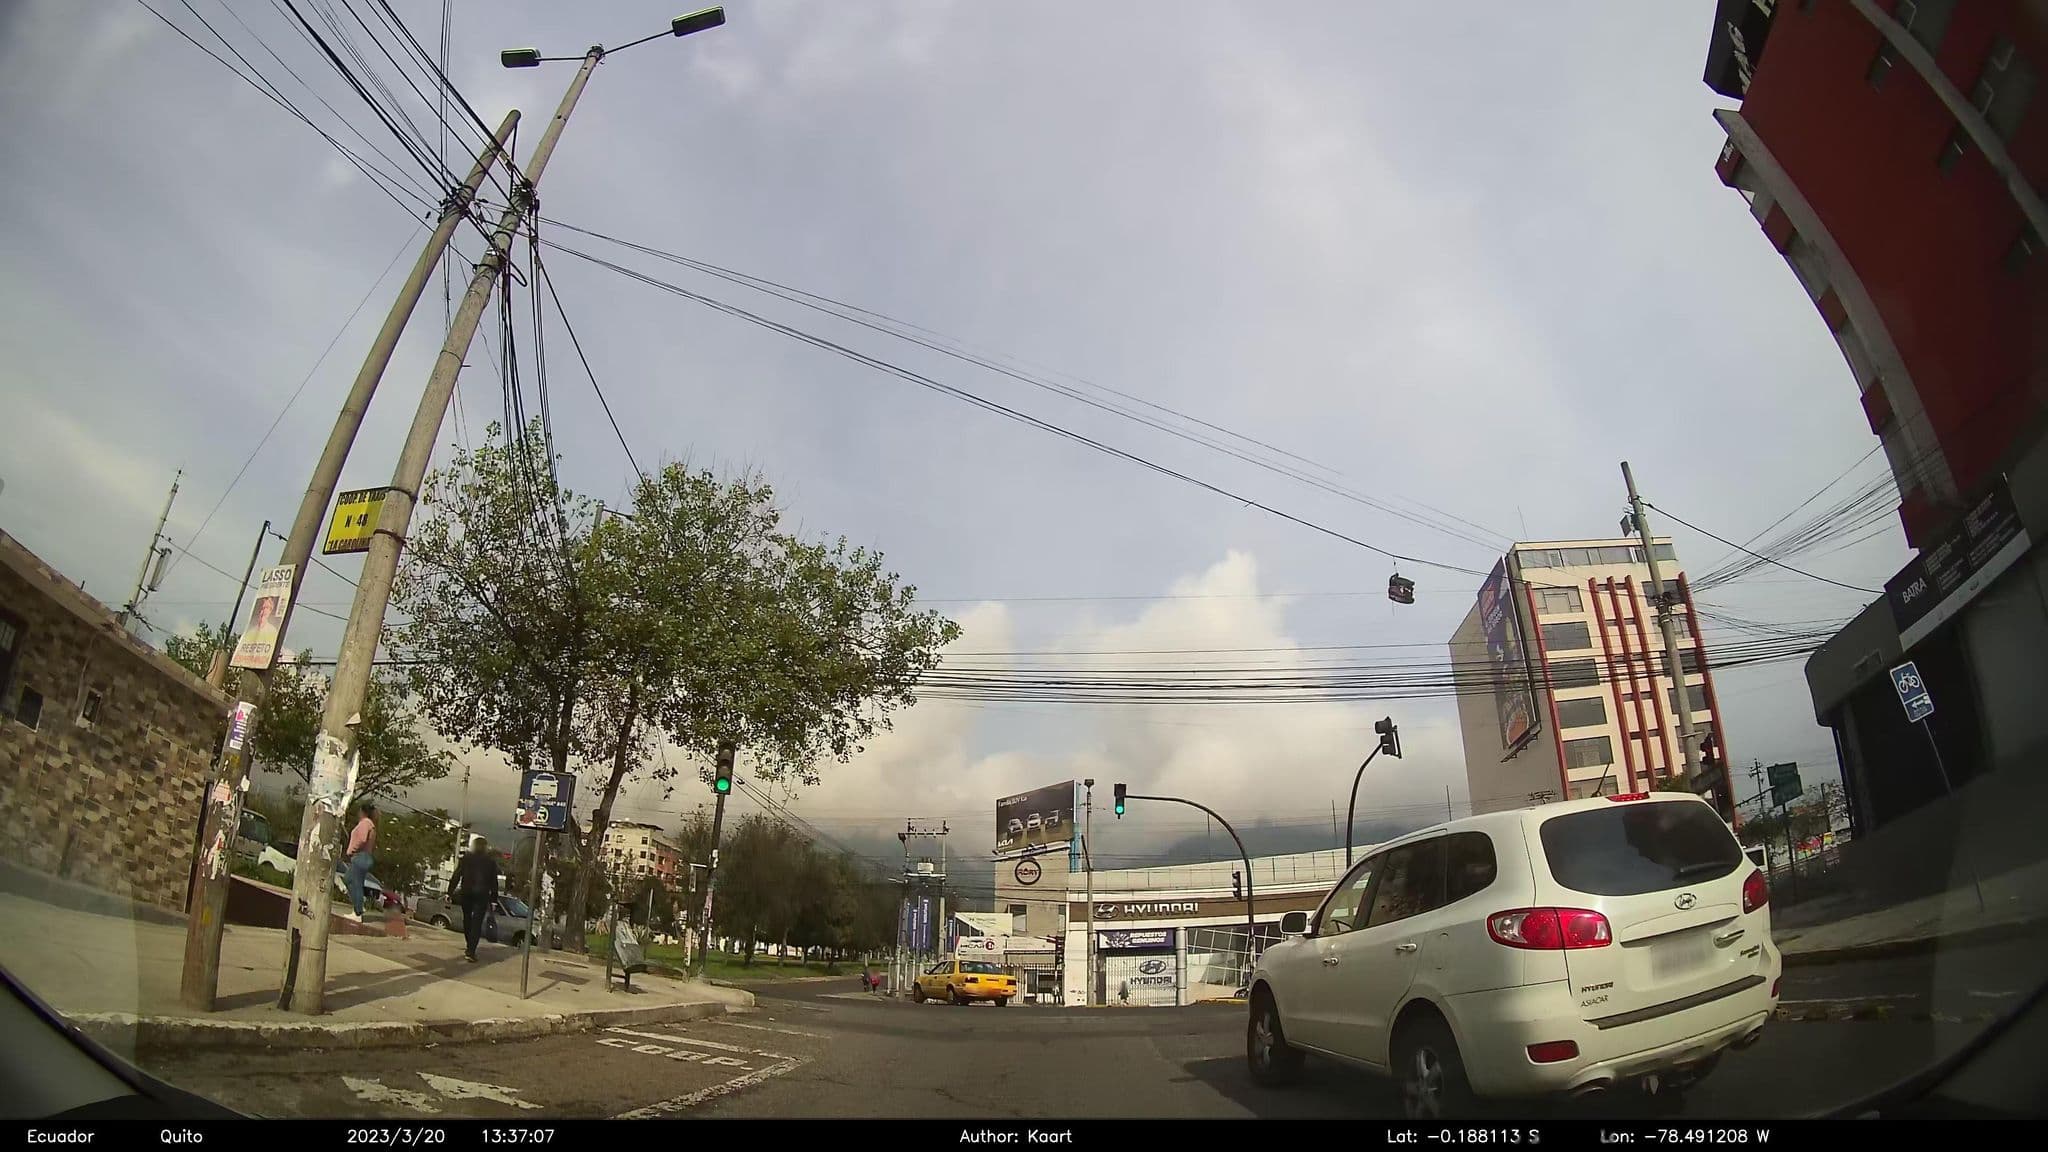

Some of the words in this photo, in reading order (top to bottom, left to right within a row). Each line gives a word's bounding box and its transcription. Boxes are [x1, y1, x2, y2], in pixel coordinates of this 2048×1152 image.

[262, 568, 292, 583] LASSO
[1901, 577, 1928, 604] BATRA
[1124, 902, 1199, 913] HYUNDAI
[1130, 976, 1173, 985] HYUNDAI
